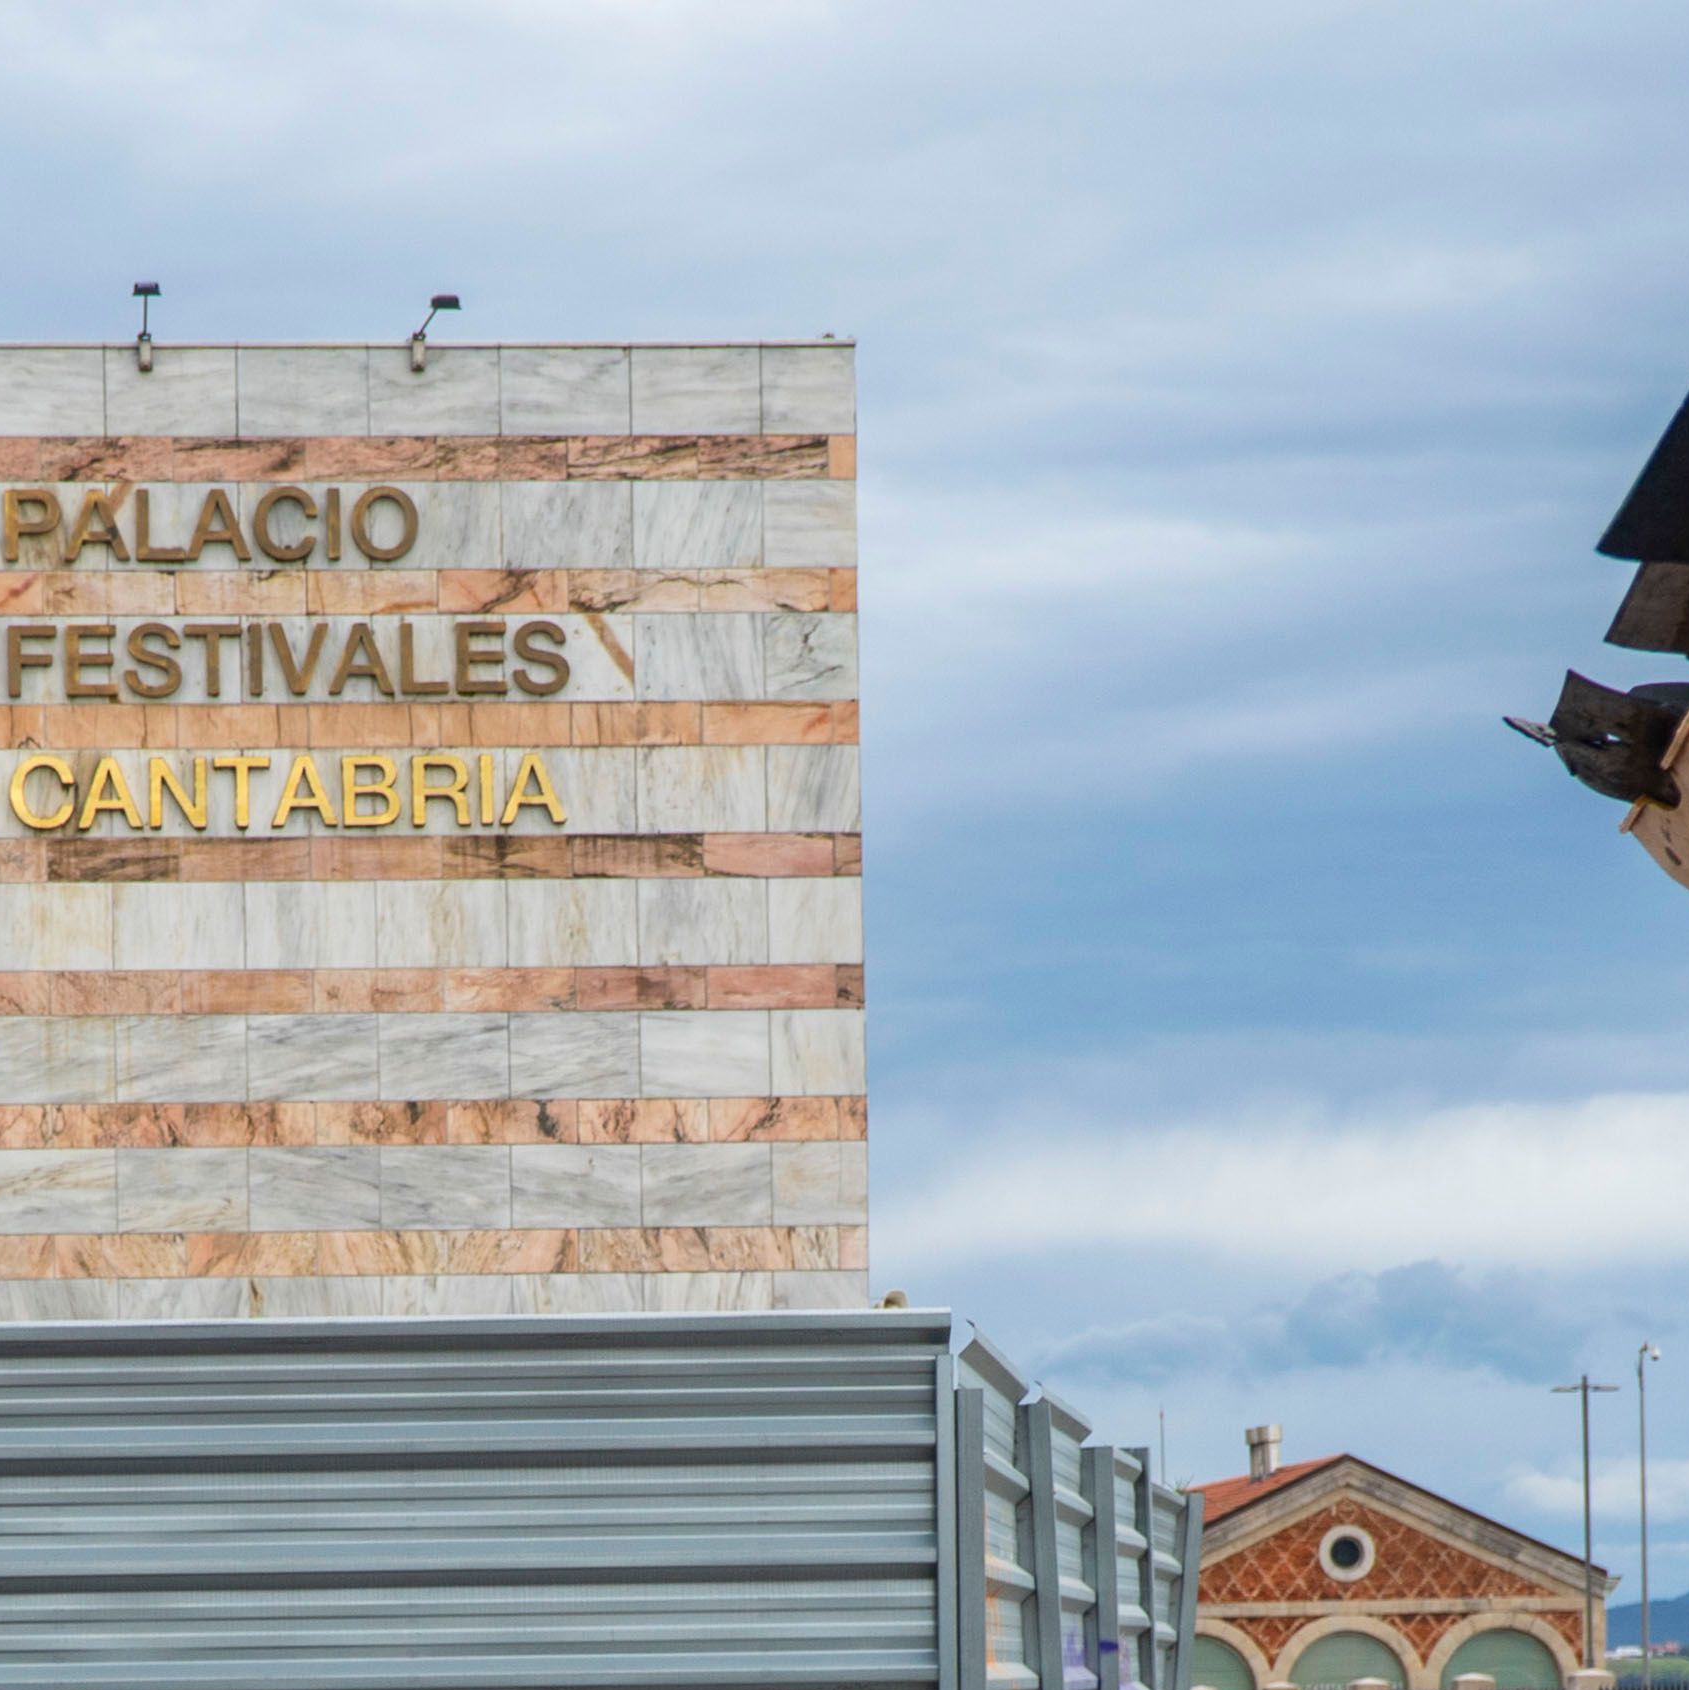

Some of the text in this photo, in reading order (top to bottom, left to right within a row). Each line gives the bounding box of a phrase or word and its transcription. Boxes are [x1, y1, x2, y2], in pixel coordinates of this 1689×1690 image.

[4, 485, 419, 563] PALACIO
[7, 620, 571, 698] FESTIVALES
[9, 753, 568, 831] CANTABRIA
